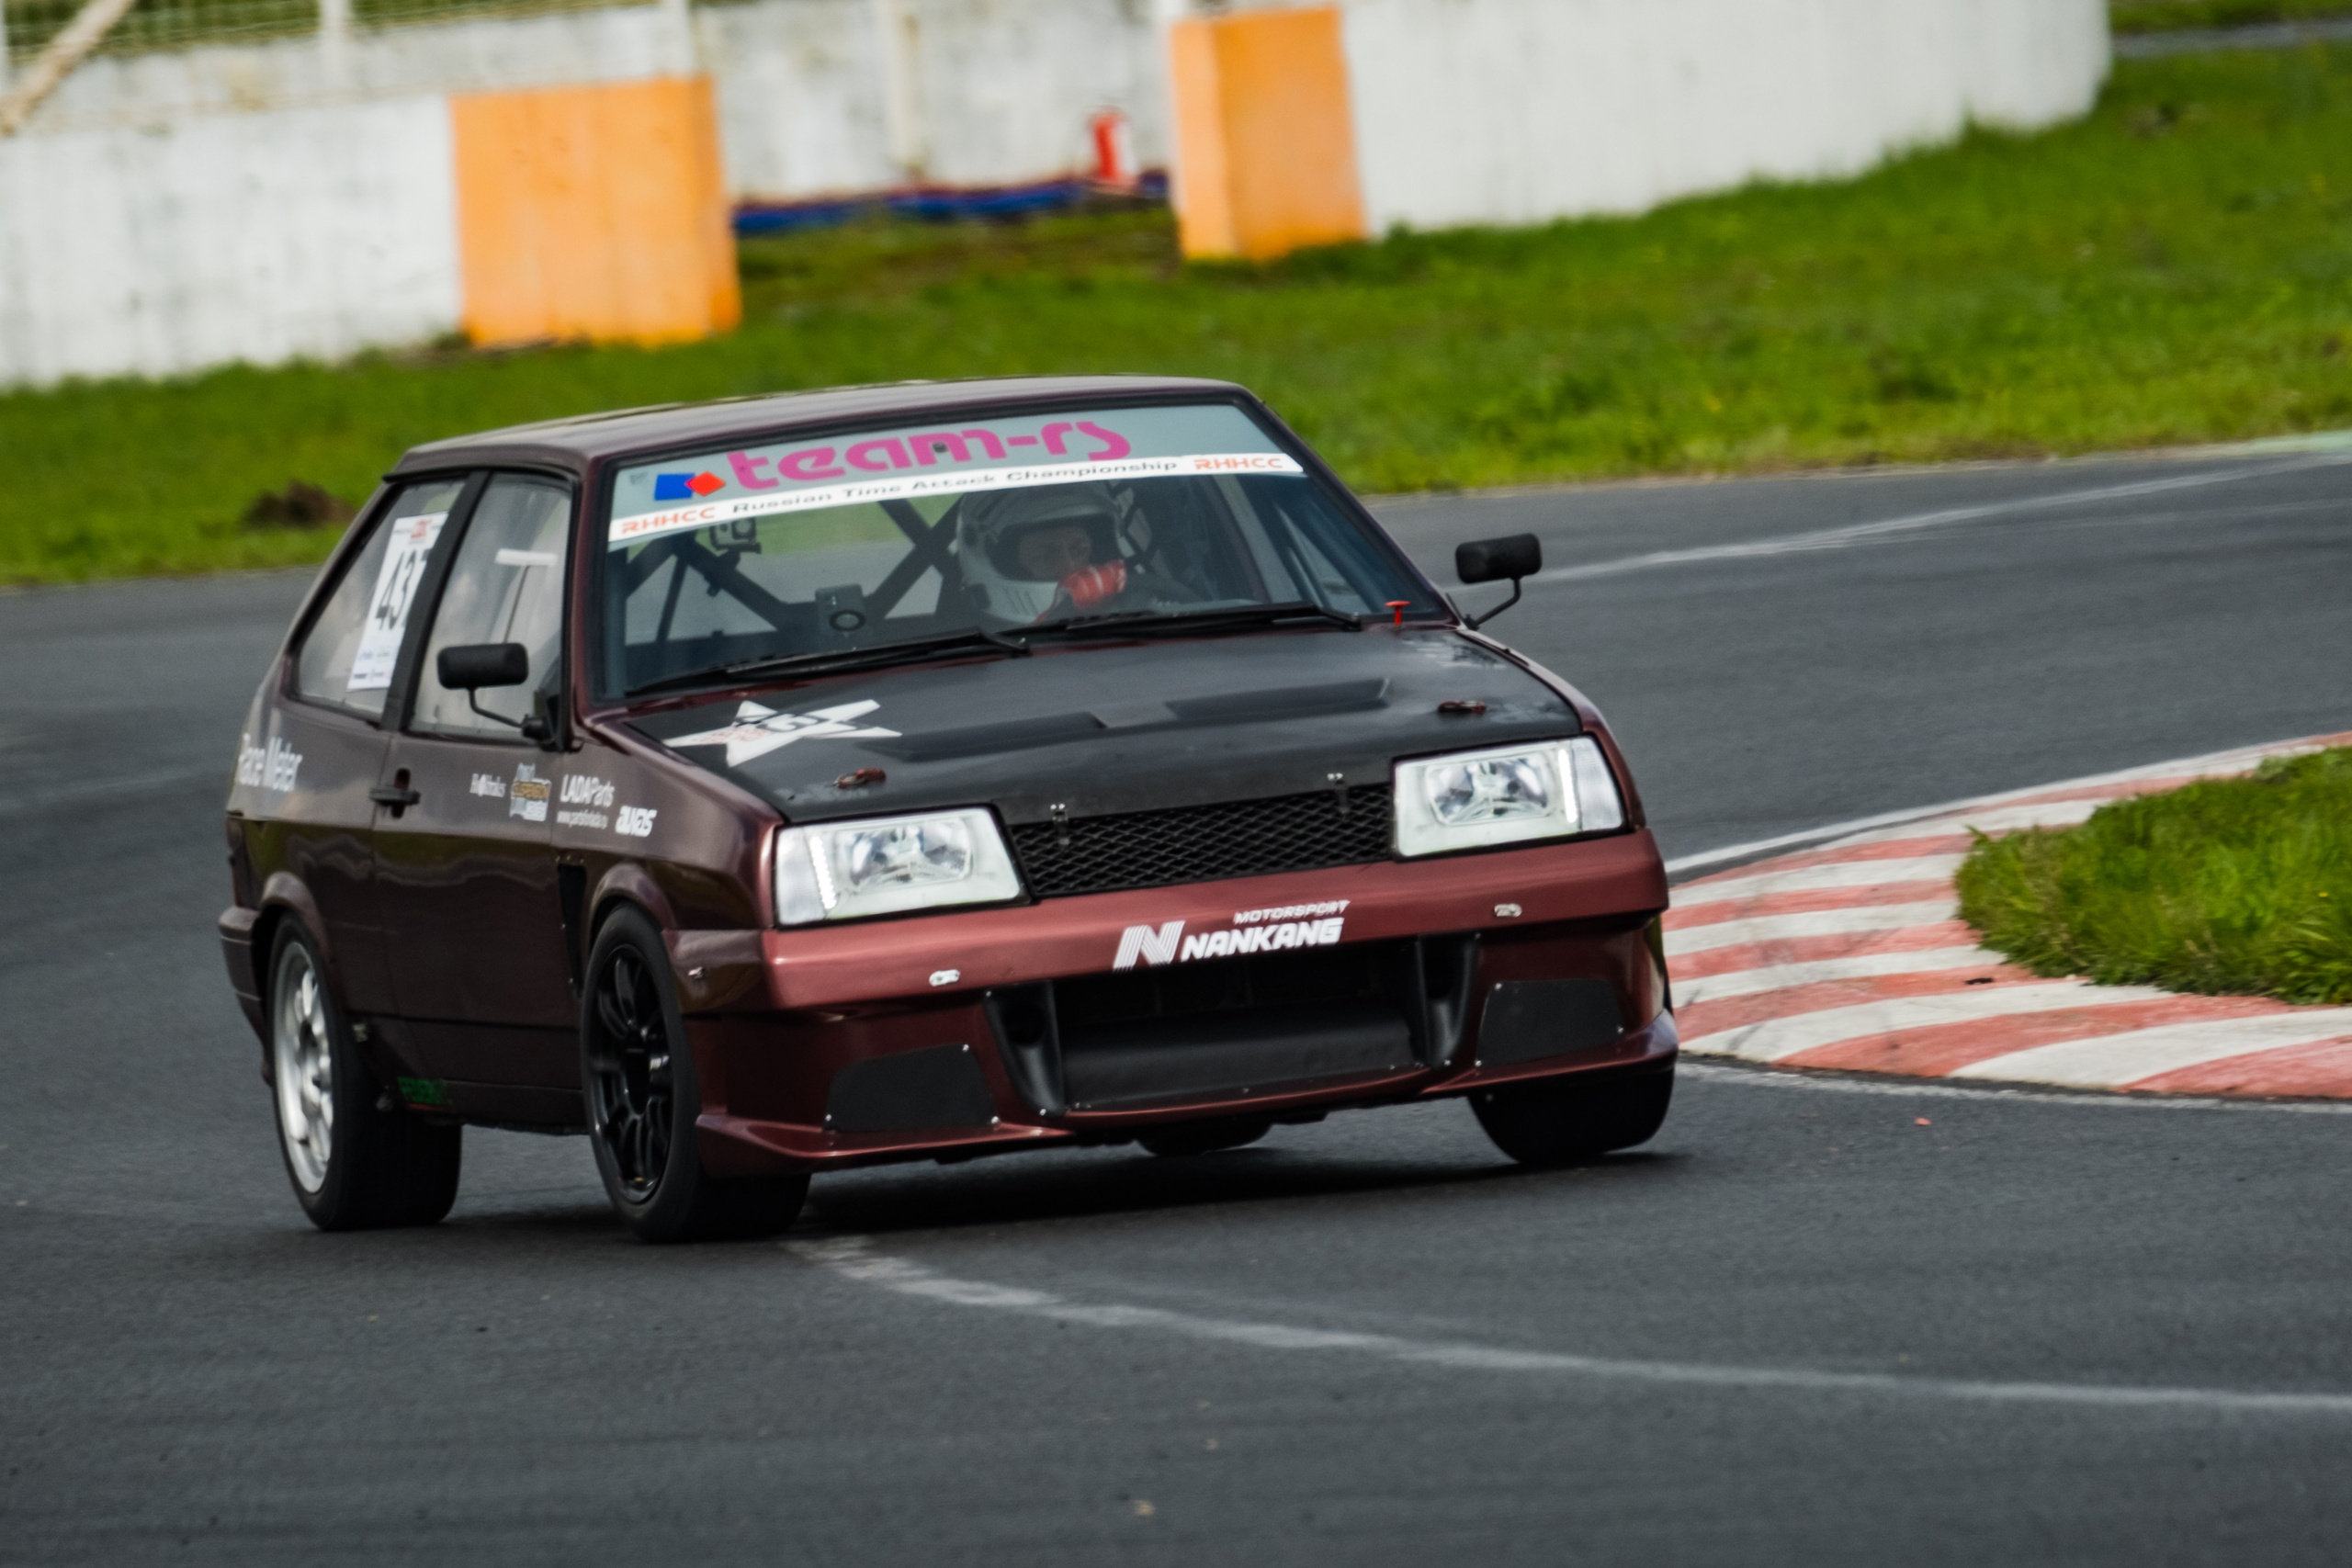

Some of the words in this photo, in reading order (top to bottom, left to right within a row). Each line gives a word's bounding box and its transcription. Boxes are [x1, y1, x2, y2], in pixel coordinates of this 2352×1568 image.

[728, 422, 1132, 491] team-rs
[621, 507, 717, 535] RHHCC
[732, 493, 832, 514] Russian
[842, 484, 902, 499] Time
[911, 473, 997, 491] Attack
[1006, 459, 1178, 481] Championship
[1194, 457, 1283, 471] RHHCC
[1180, 917, 1345, 963] NANKANG
[1233, 899, 1351, 926] MOTORSPORT
